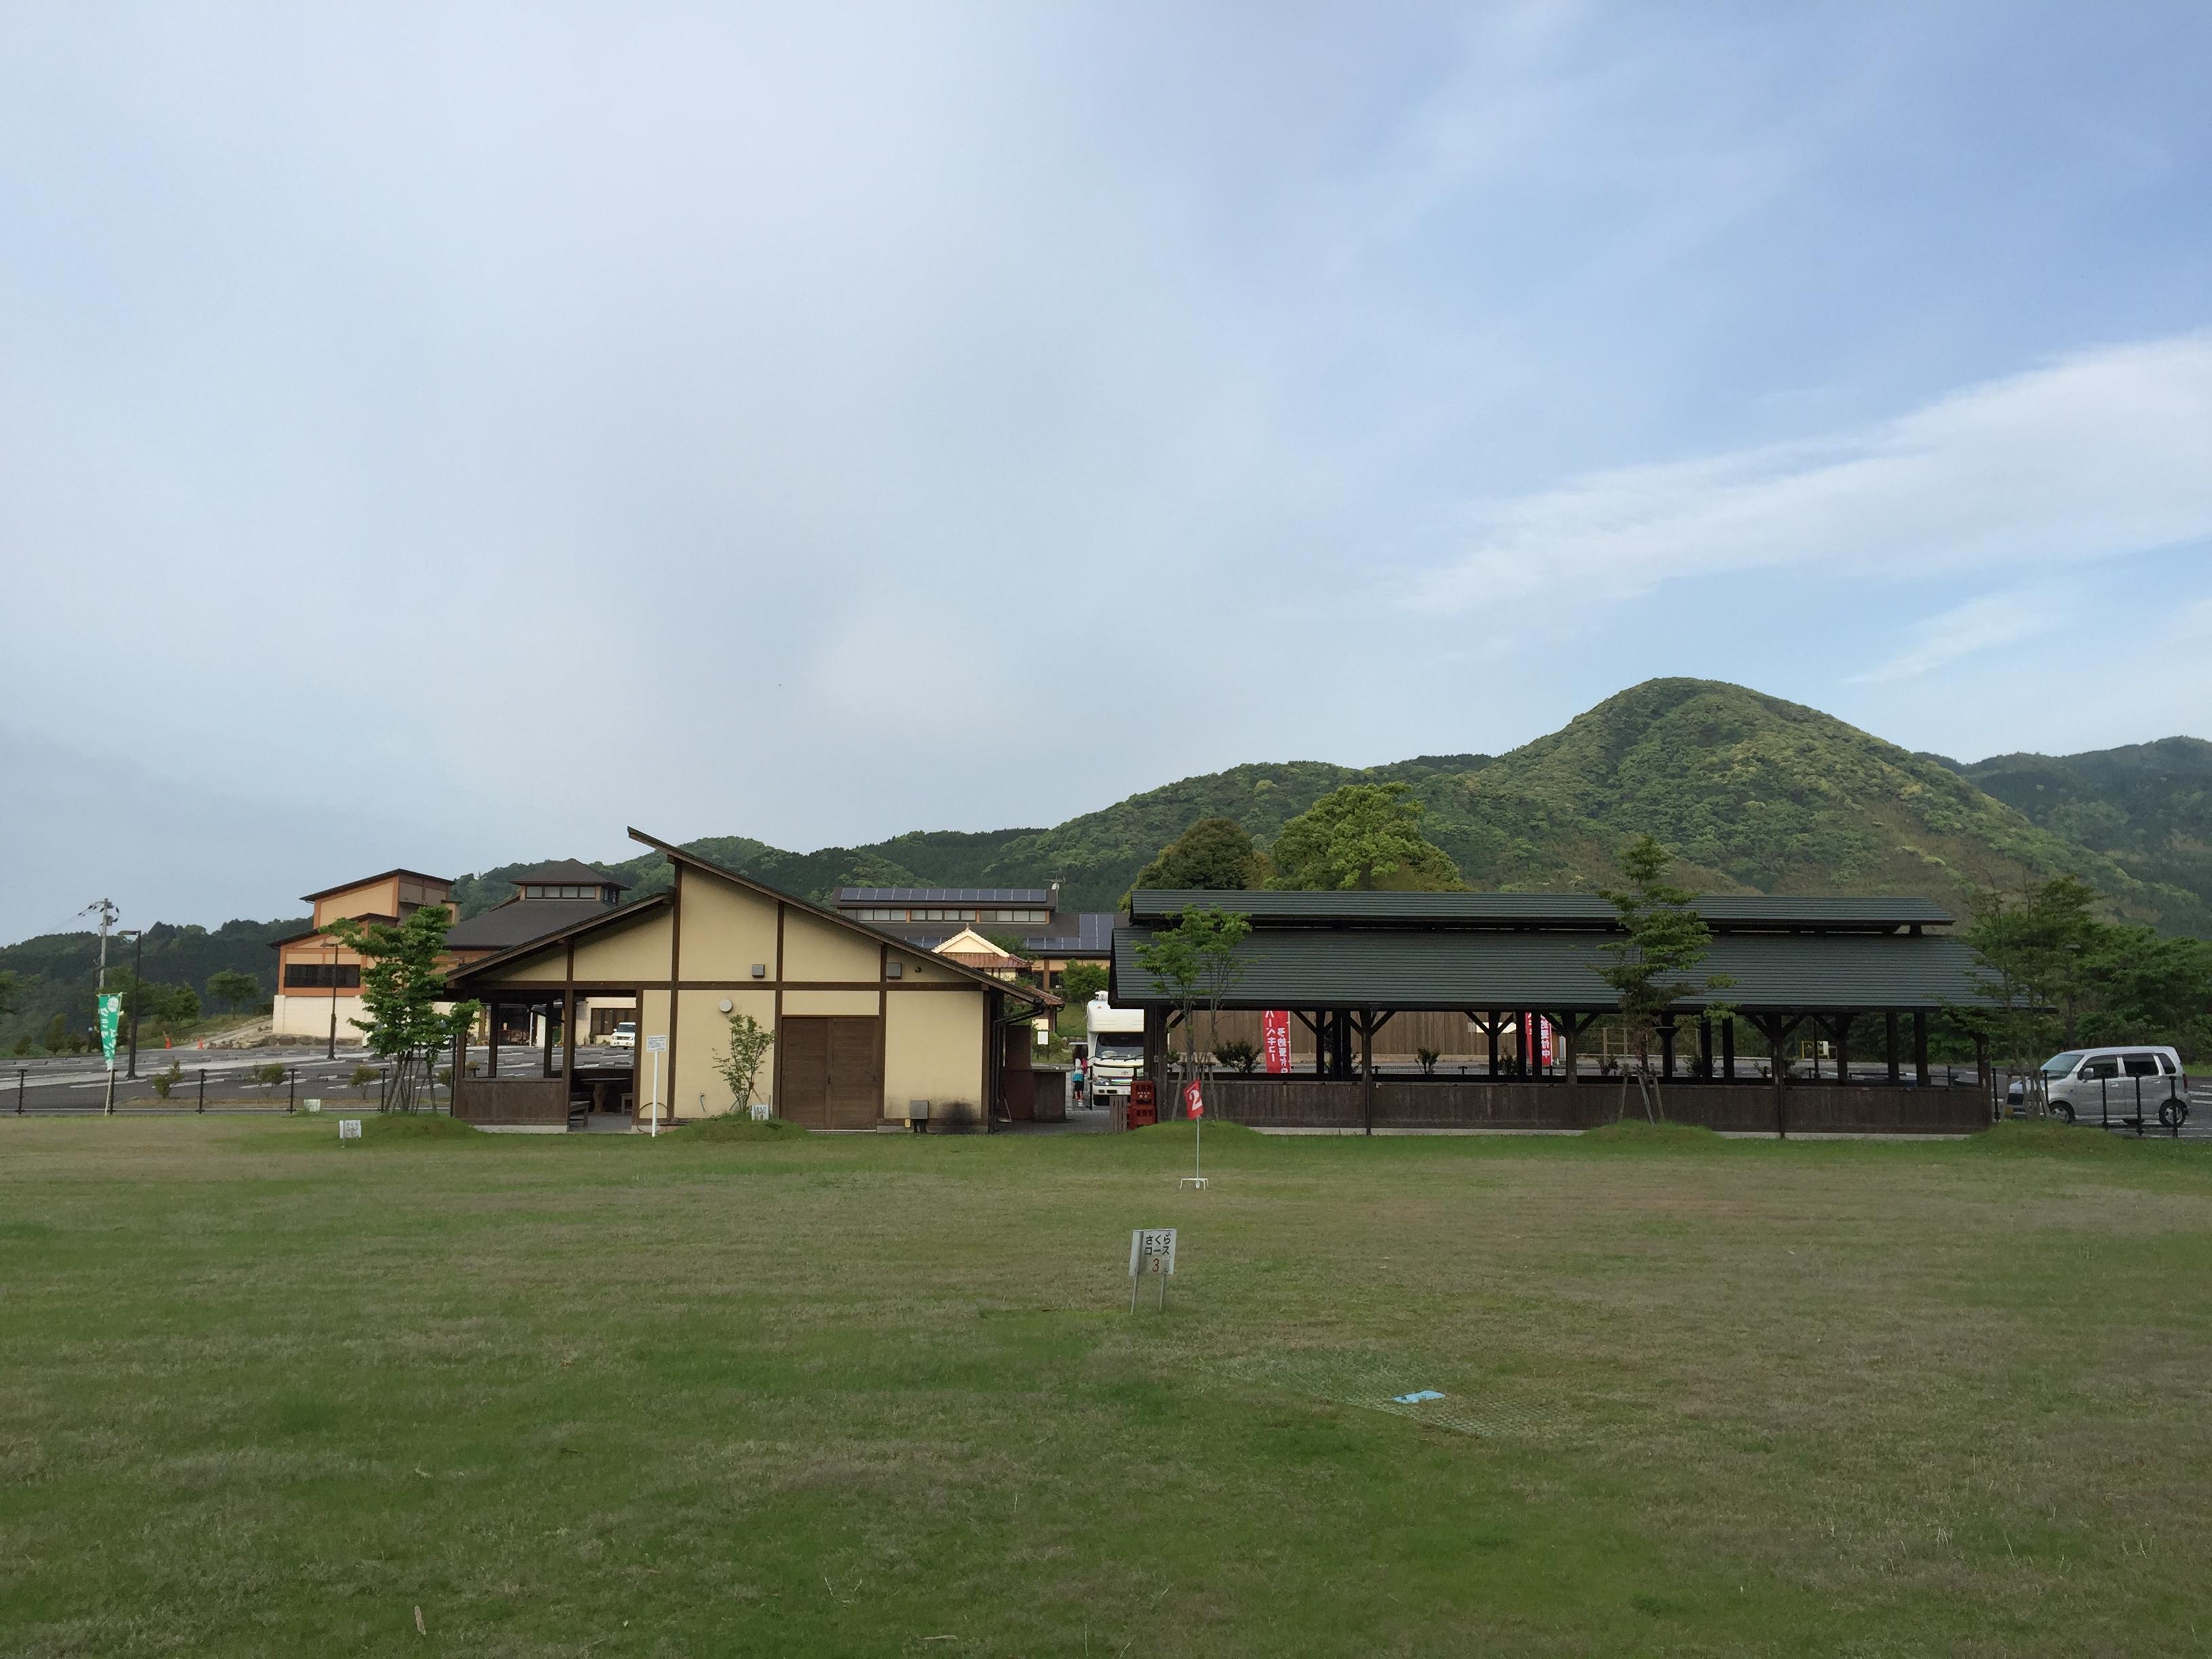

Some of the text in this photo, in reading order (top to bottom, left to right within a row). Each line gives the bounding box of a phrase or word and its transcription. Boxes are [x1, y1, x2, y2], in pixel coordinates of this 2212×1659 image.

[1189, 1089, 1203, 1111] 2
[1145, 1235, 1171, 1245] さくら
[1144, 1246, 1170, 1256] コース
[1152, 1258, 1160, 1273] 3
